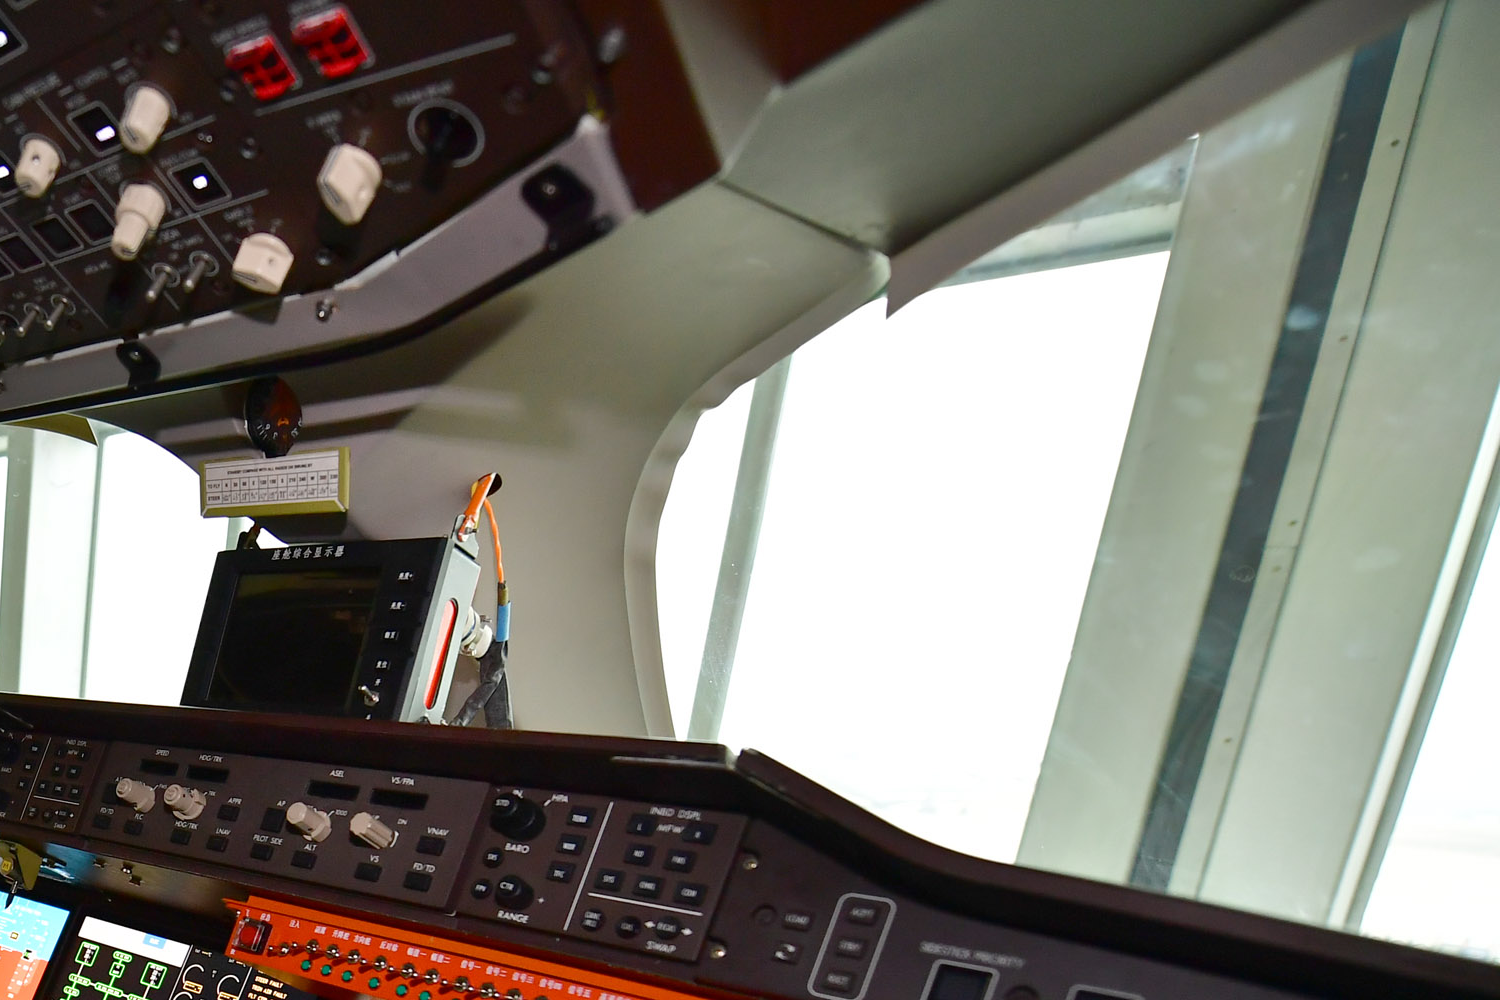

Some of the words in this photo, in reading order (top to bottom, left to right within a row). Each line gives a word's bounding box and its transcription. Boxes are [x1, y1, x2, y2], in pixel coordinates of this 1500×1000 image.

[271, 545, 345, 561] 座舱综合显示器
[155, 749, 170, 757] SPEED
[199, 754, 224, 763] HDG/TRK
[329, 769, 345, 778] ASEL
[391, 776, 415, 786] VS/FPA
[174, 820, 199, 831] HDG/TRK
[215, 827, 231, 836] LNAV
[427, 826, 450, 837] VNAV
[253, 834, 269, 844] PILOT
[270, 837, 284, 846] SIDE
[303, 844, 317, 852] ALT
[505, 842, 530, 854] BARO
[369, 854, 380, 863] VS
[412, 862, 436, 873] FD/TD
[497, 910, 529, 924] RANGE
[645, 940, 677, 953] SWAP
[269, 980, 284, 989] FAULT
[273, 990, 288, 999] FAULT
